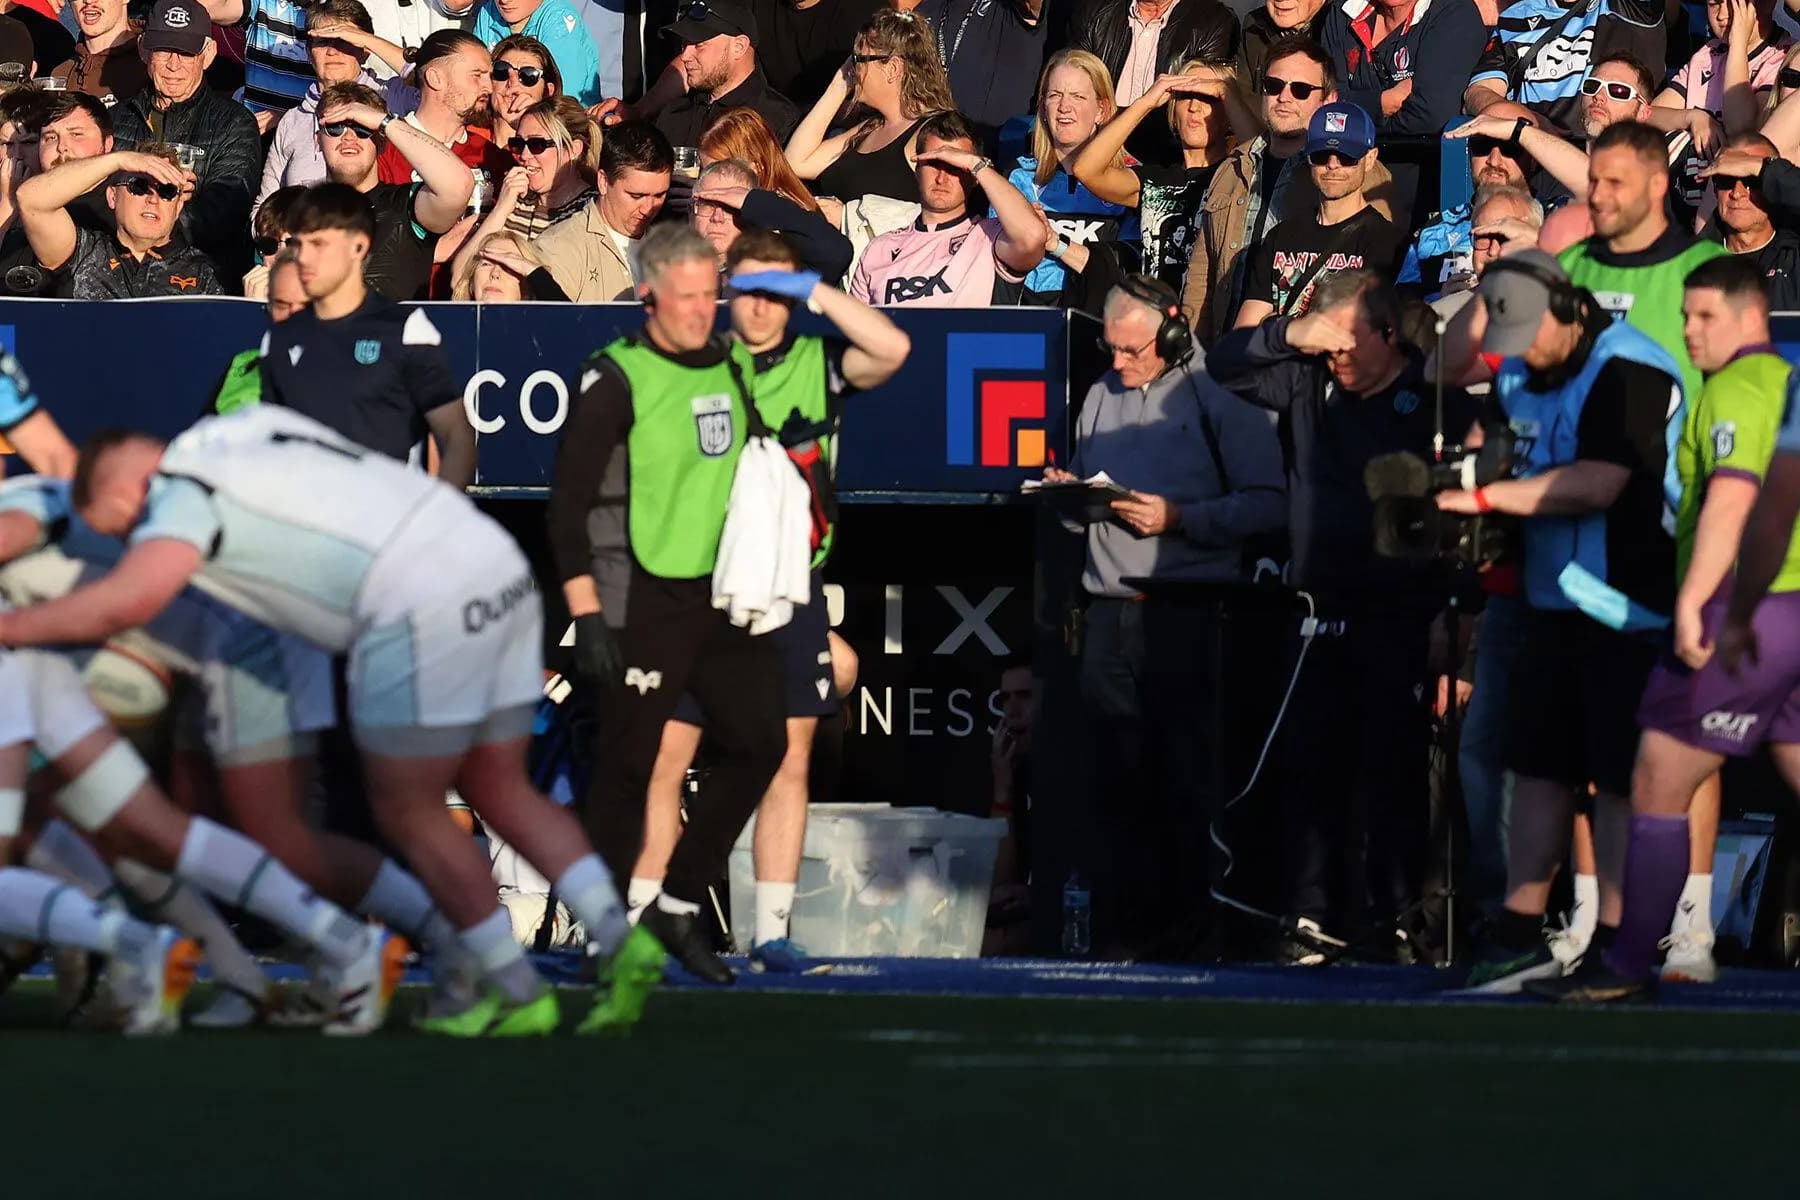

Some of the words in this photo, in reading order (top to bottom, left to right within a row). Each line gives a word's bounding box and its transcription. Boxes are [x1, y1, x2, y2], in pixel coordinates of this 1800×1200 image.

[1047, 219, 1103, 242] SK
[885, 265, 952, 304] RSK
[861, 687, 1004, 737] NESS
